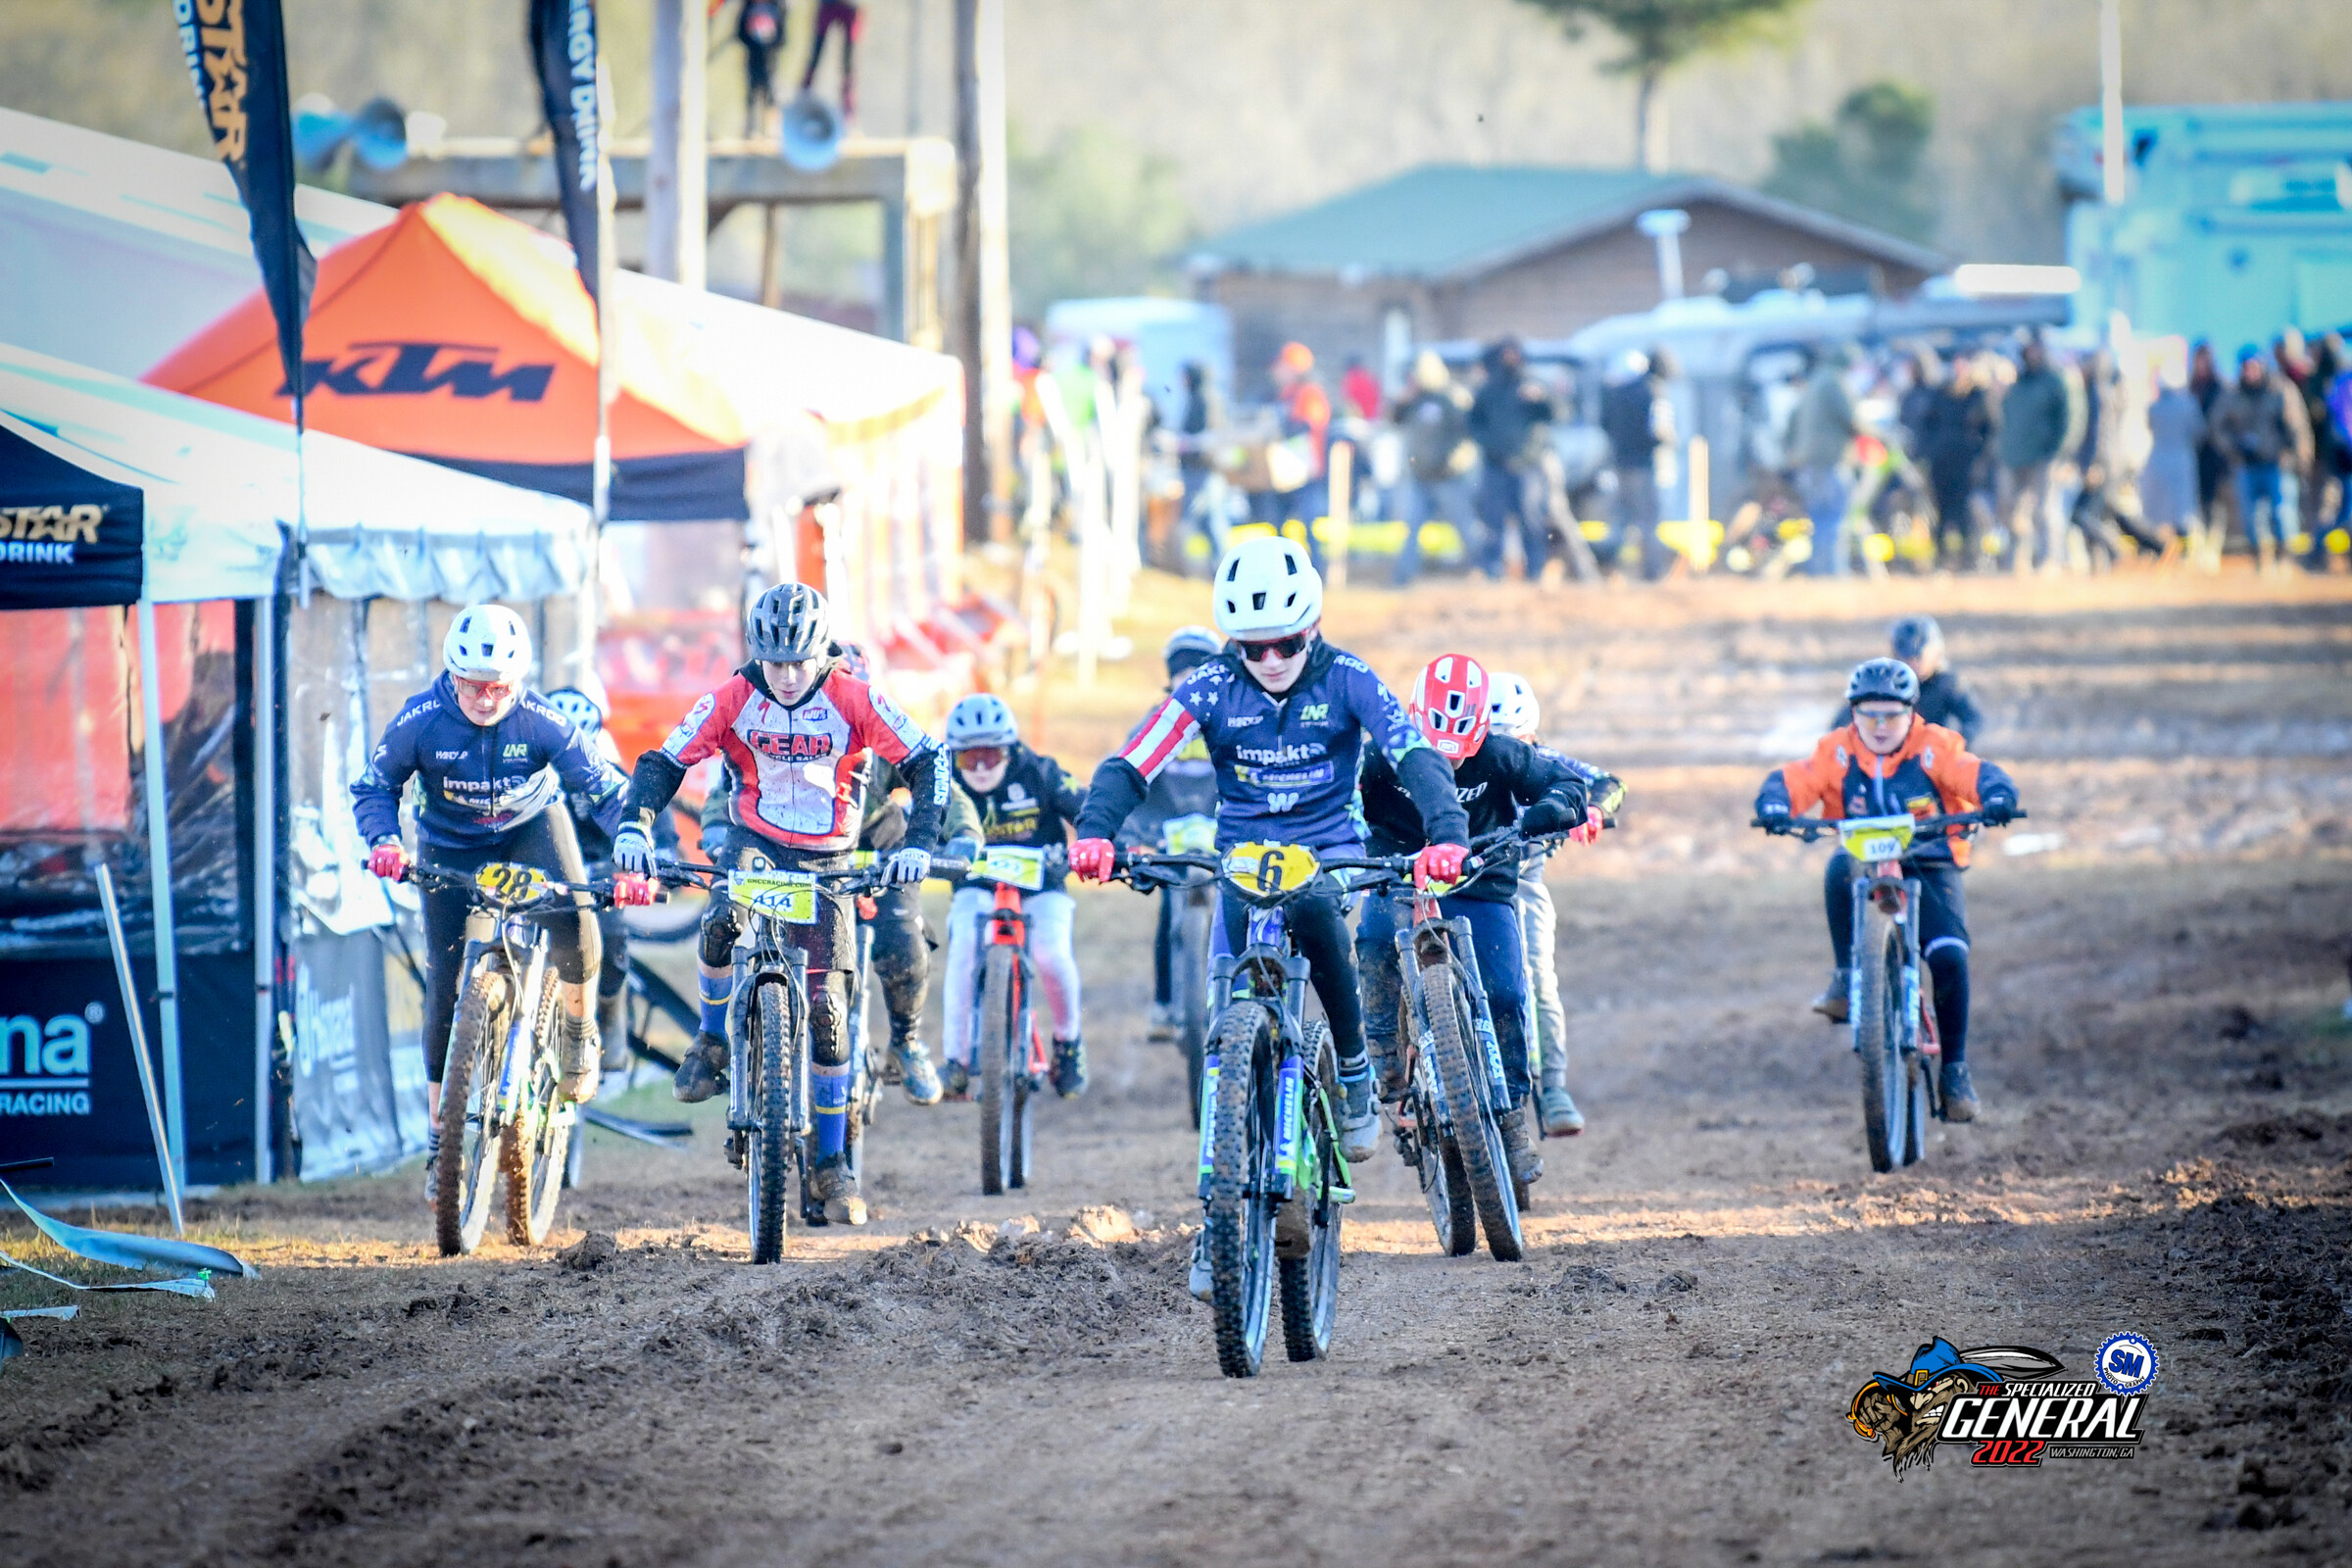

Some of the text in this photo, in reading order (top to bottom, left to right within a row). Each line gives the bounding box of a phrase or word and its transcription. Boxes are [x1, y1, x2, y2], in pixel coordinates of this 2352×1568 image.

[274, 341, 556, 403] KTM
[750, 731, 831, 757] GEAR
[443, 775, 511, 792] impakt
[492, 867, 533, 901] 28
[1257, 850, 1285, 893] 6
